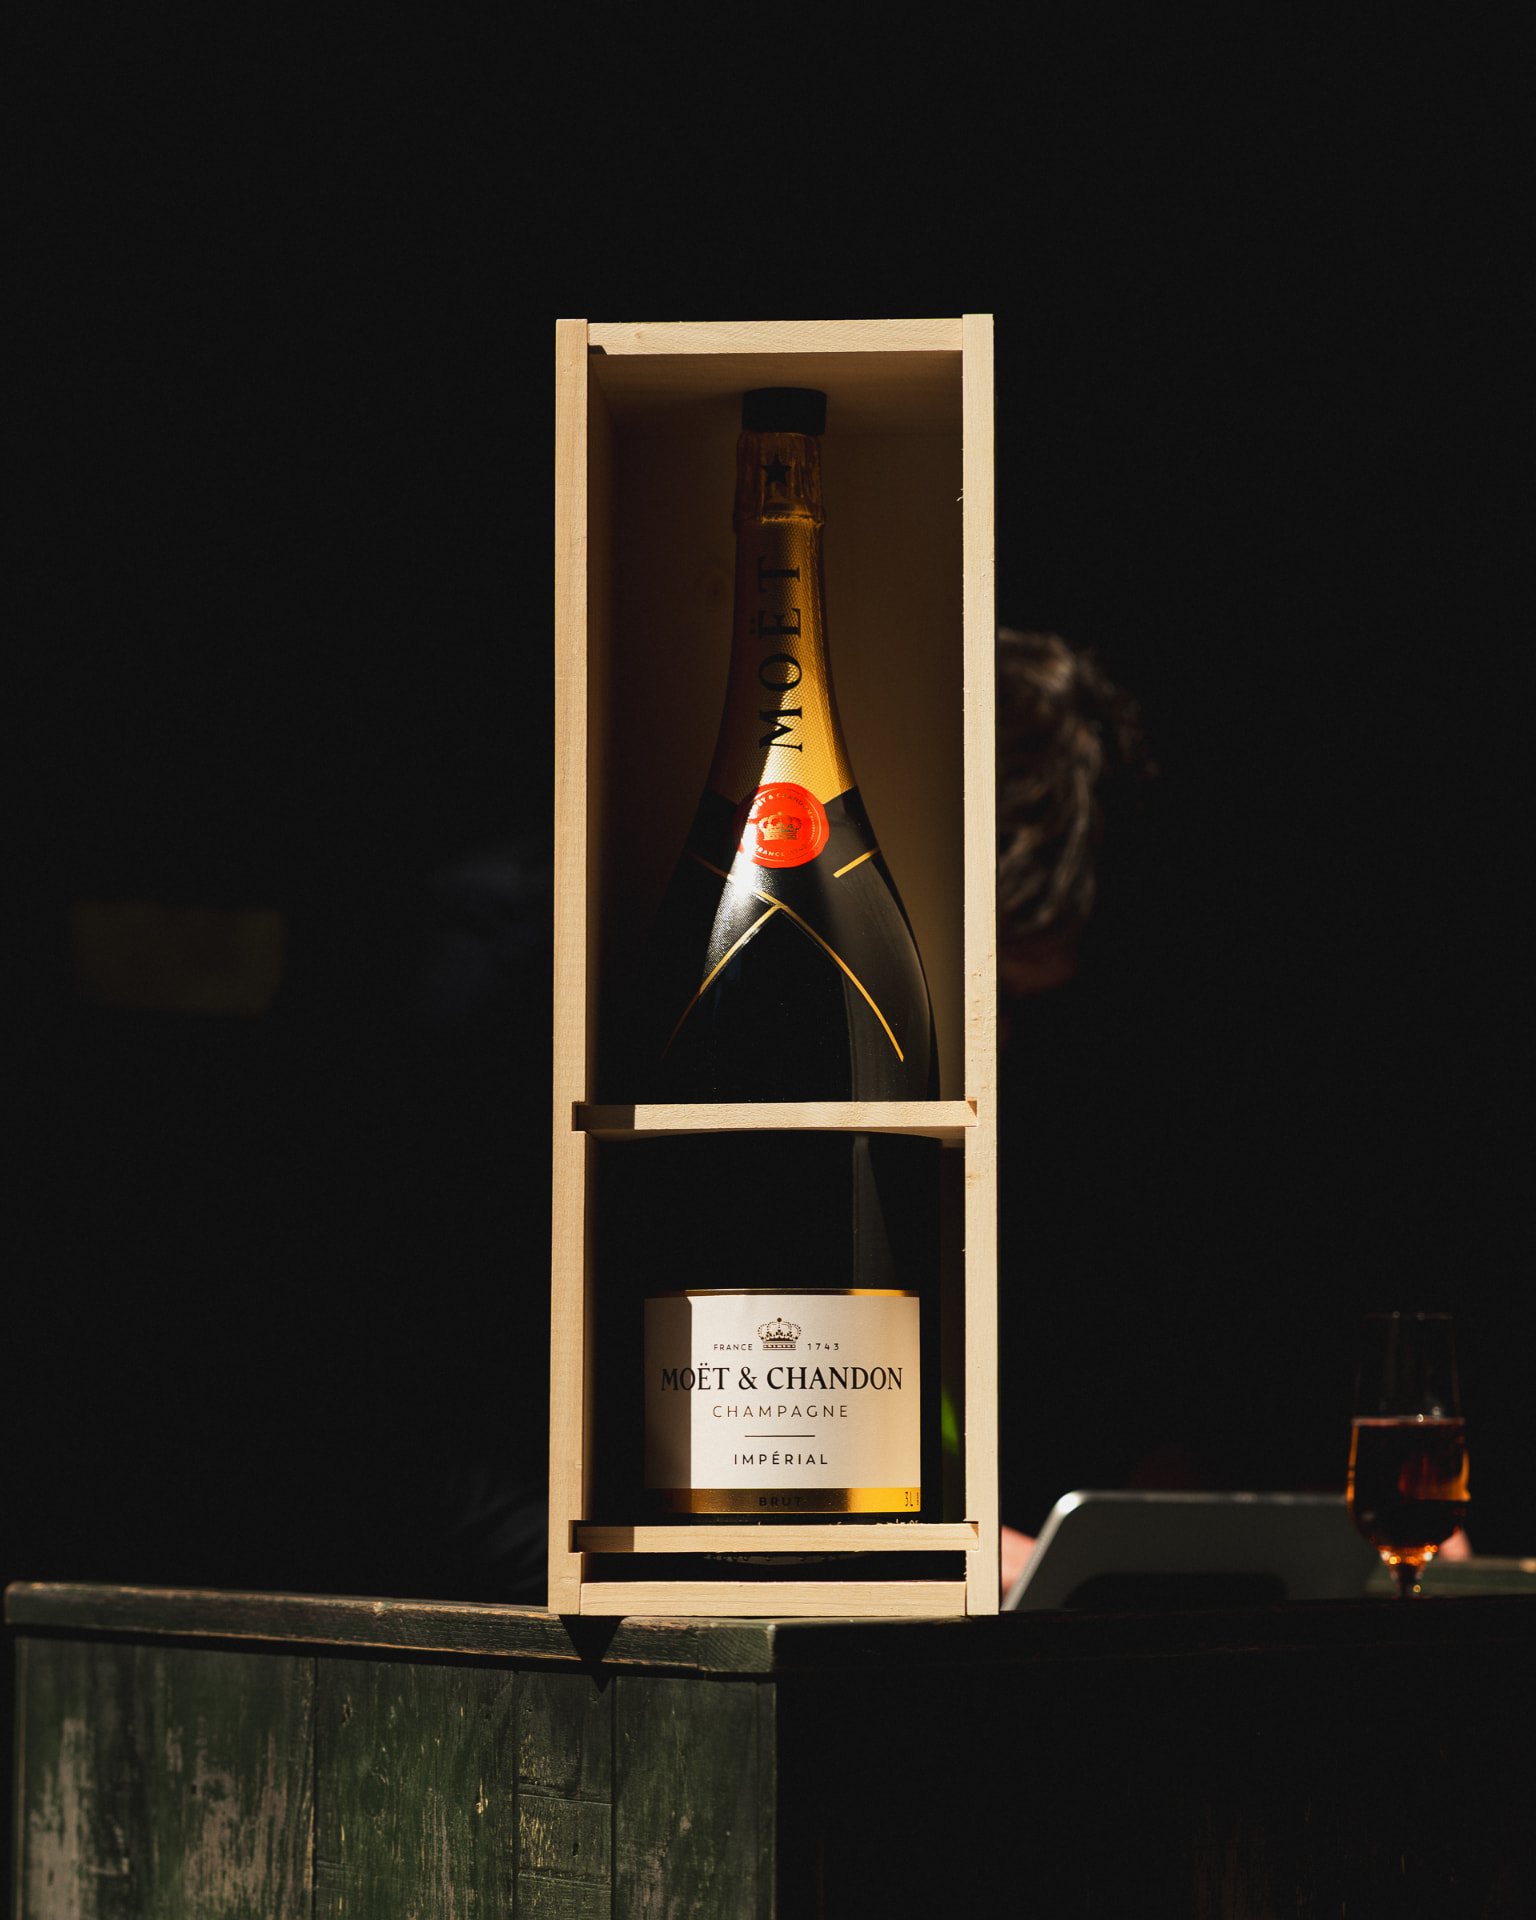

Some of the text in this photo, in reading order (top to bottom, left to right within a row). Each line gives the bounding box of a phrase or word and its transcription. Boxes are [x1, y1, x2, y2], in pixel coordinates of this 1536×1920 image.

[749, 555, 802, 752] MOËT
[713, 1343, 840, 1351] FRANCE 1743
[661, 1362, 903, 1391] MOËT & CHANDON
[712, 1404, 849, 1418] CHAMPAGNE
[734, 1450, 829, 1465] IMPÉRIAL
[758, 1496, 803, 1507] BRUT
